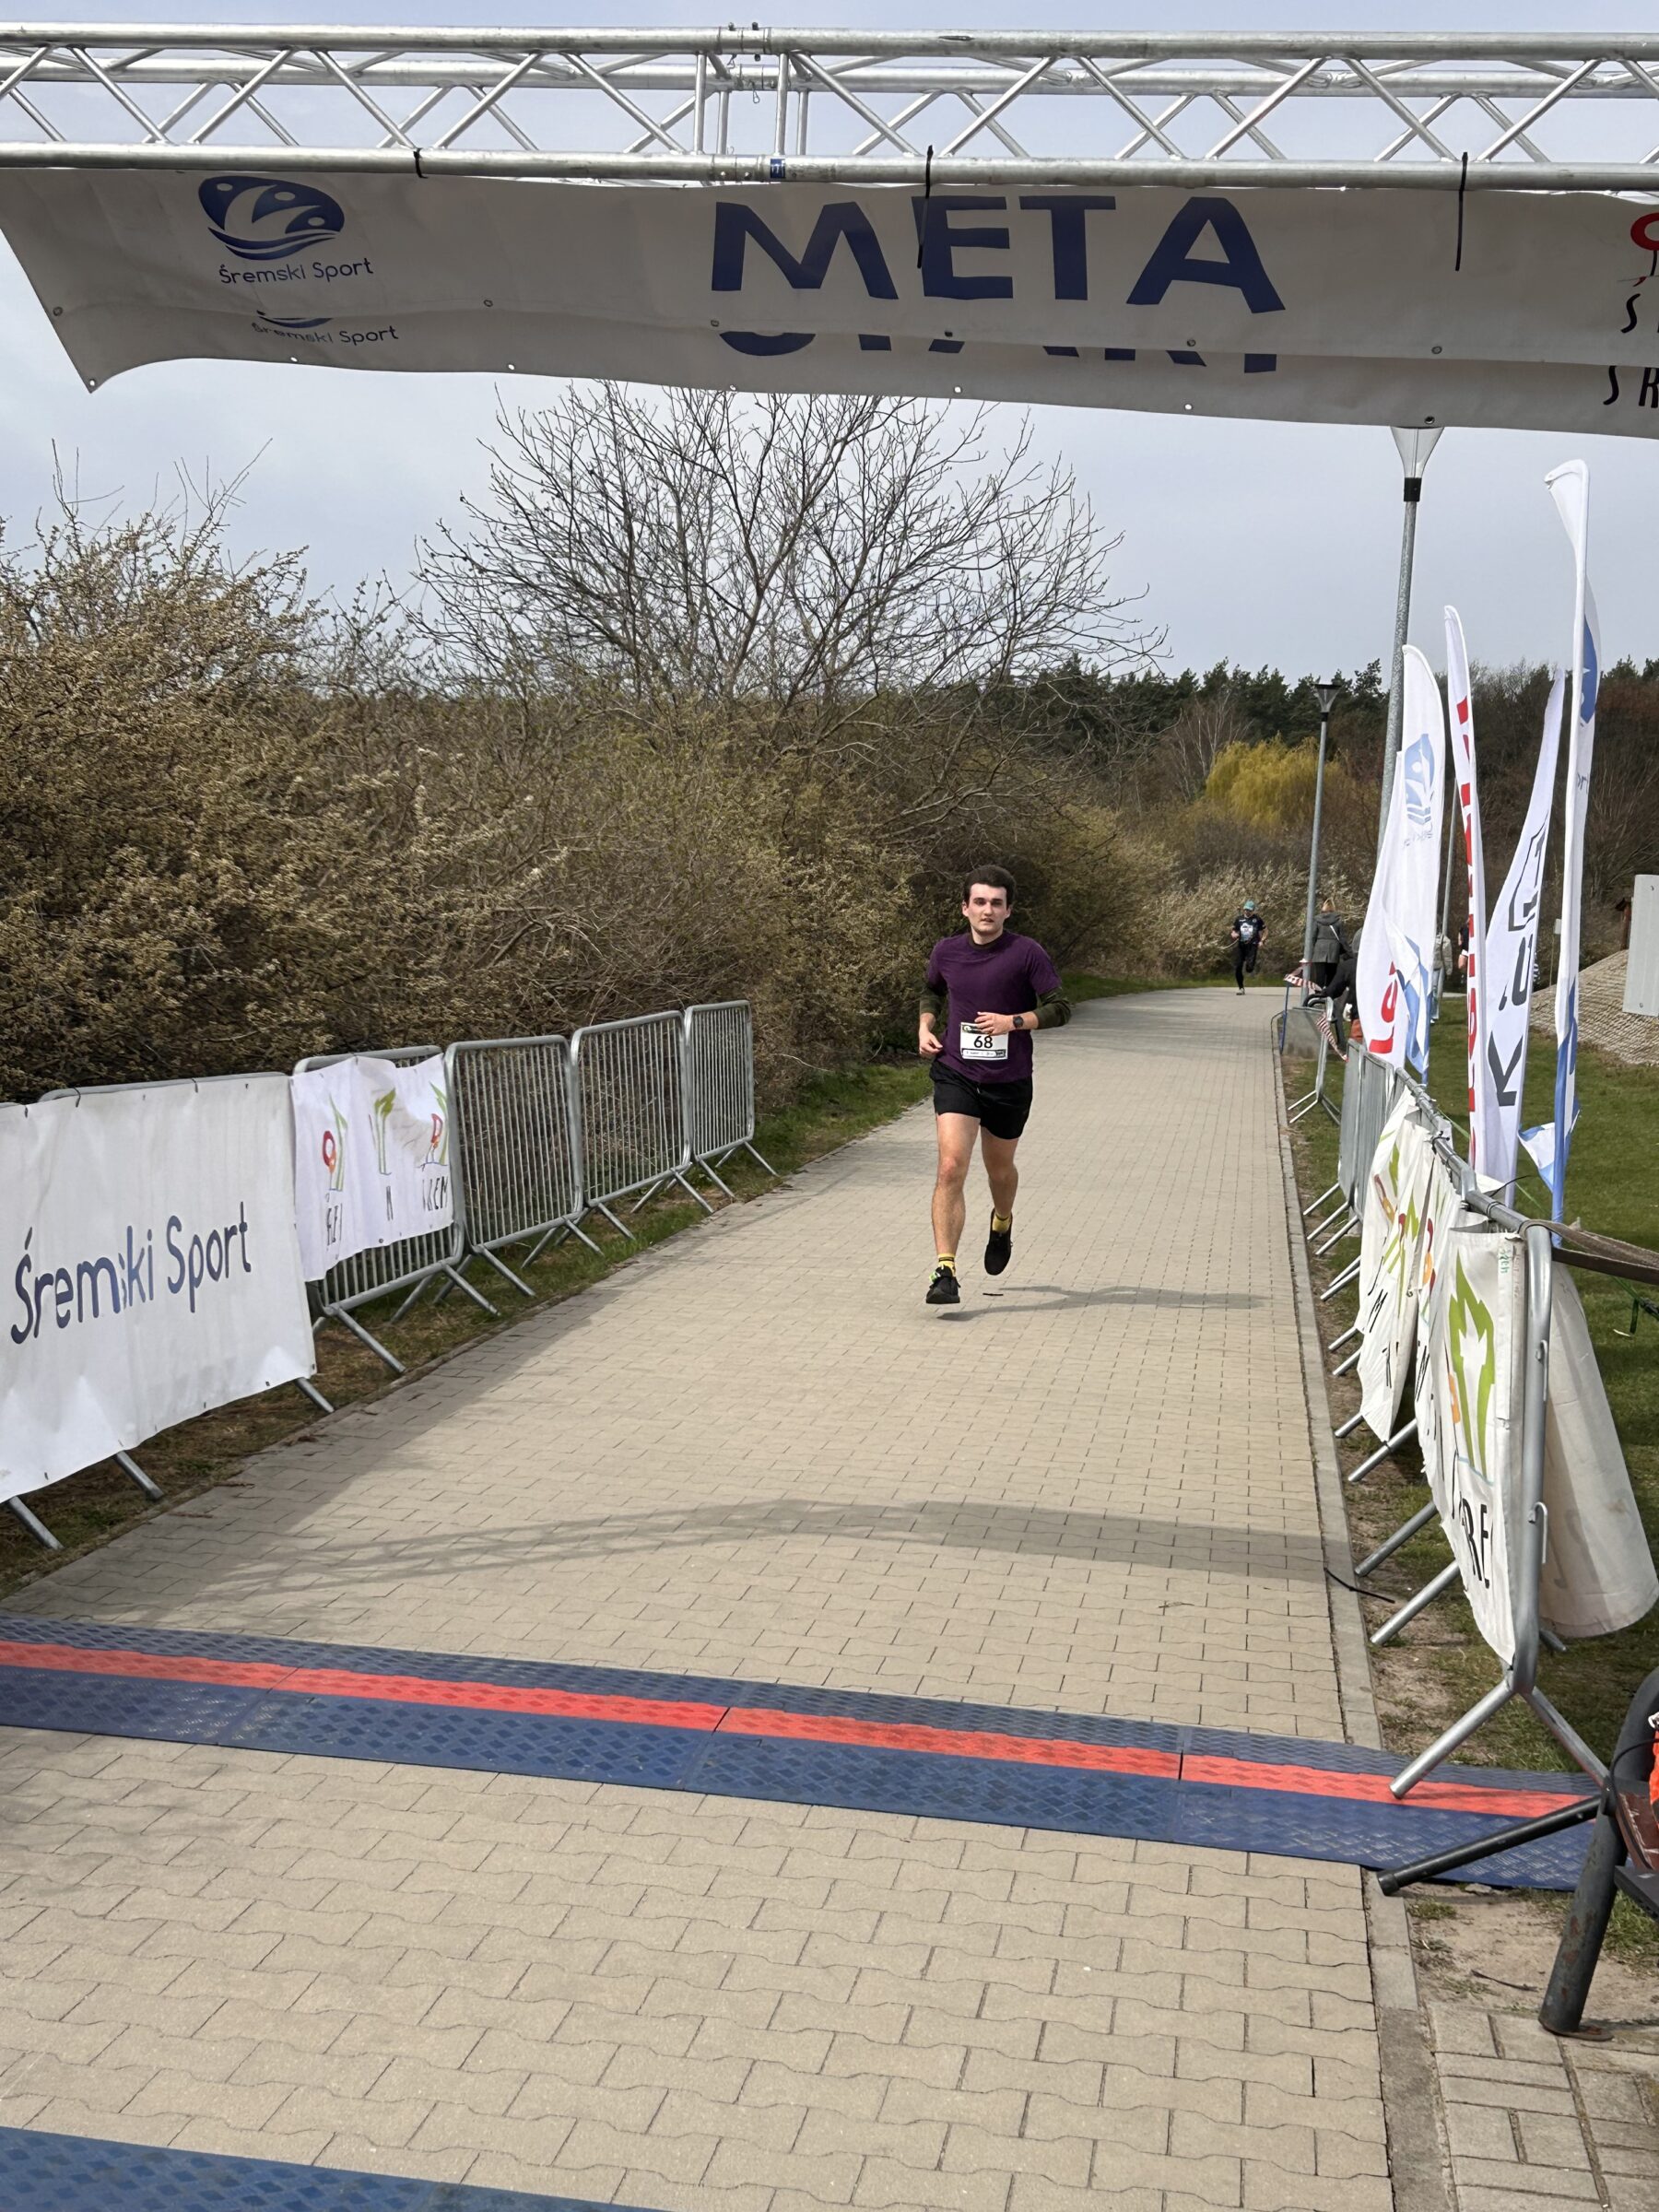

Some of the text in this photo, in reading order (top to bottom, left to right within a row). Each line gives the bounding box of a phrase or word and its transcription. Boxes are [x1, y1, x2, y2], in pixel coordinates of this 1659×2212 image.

[712, 194, 1286, 313] META
[218, 258, 374, 284] Śremski Sport
[339, 325, 399, 346] Sport
[973, 1035, 994, 1049] 68
[167, 1201, 252, 1313] Sport
